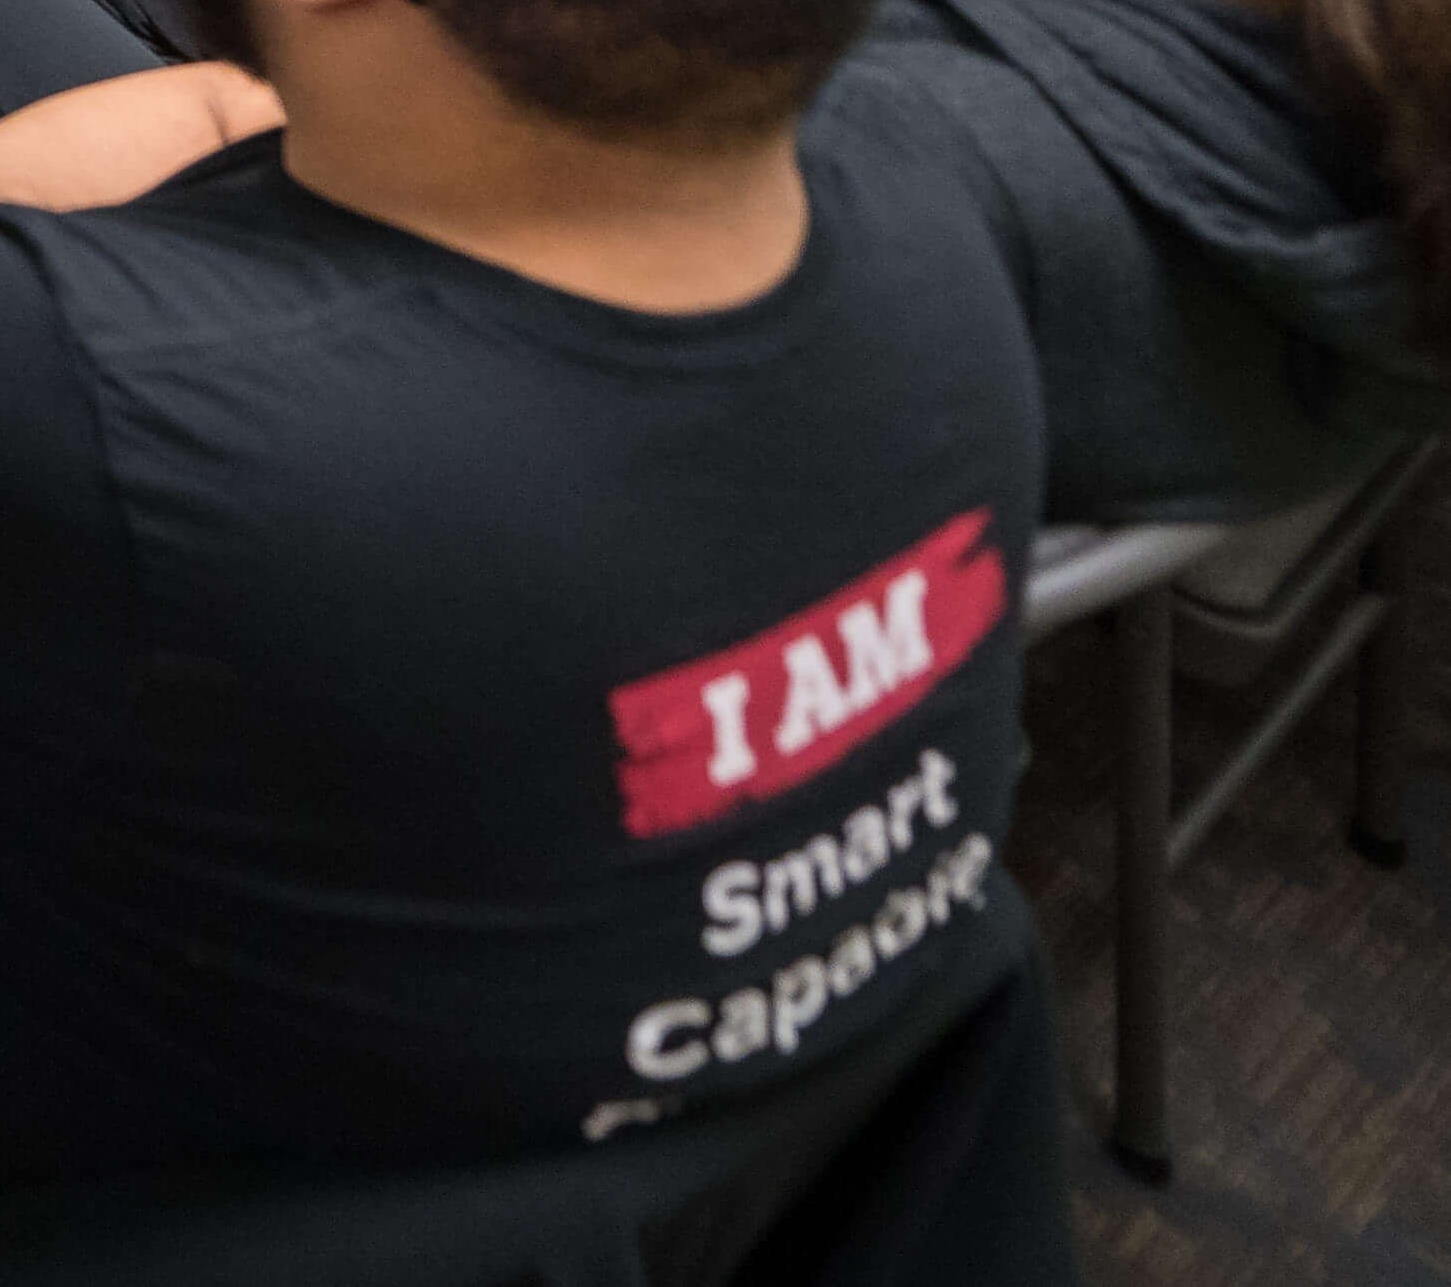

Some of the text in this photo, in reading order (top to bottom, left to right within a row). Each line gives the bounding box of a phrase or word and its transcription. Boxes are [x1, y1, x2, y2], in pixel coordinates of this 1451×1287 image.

[700, 568, 934, 787] I AM
[701, 747, 957, 958] Smart
